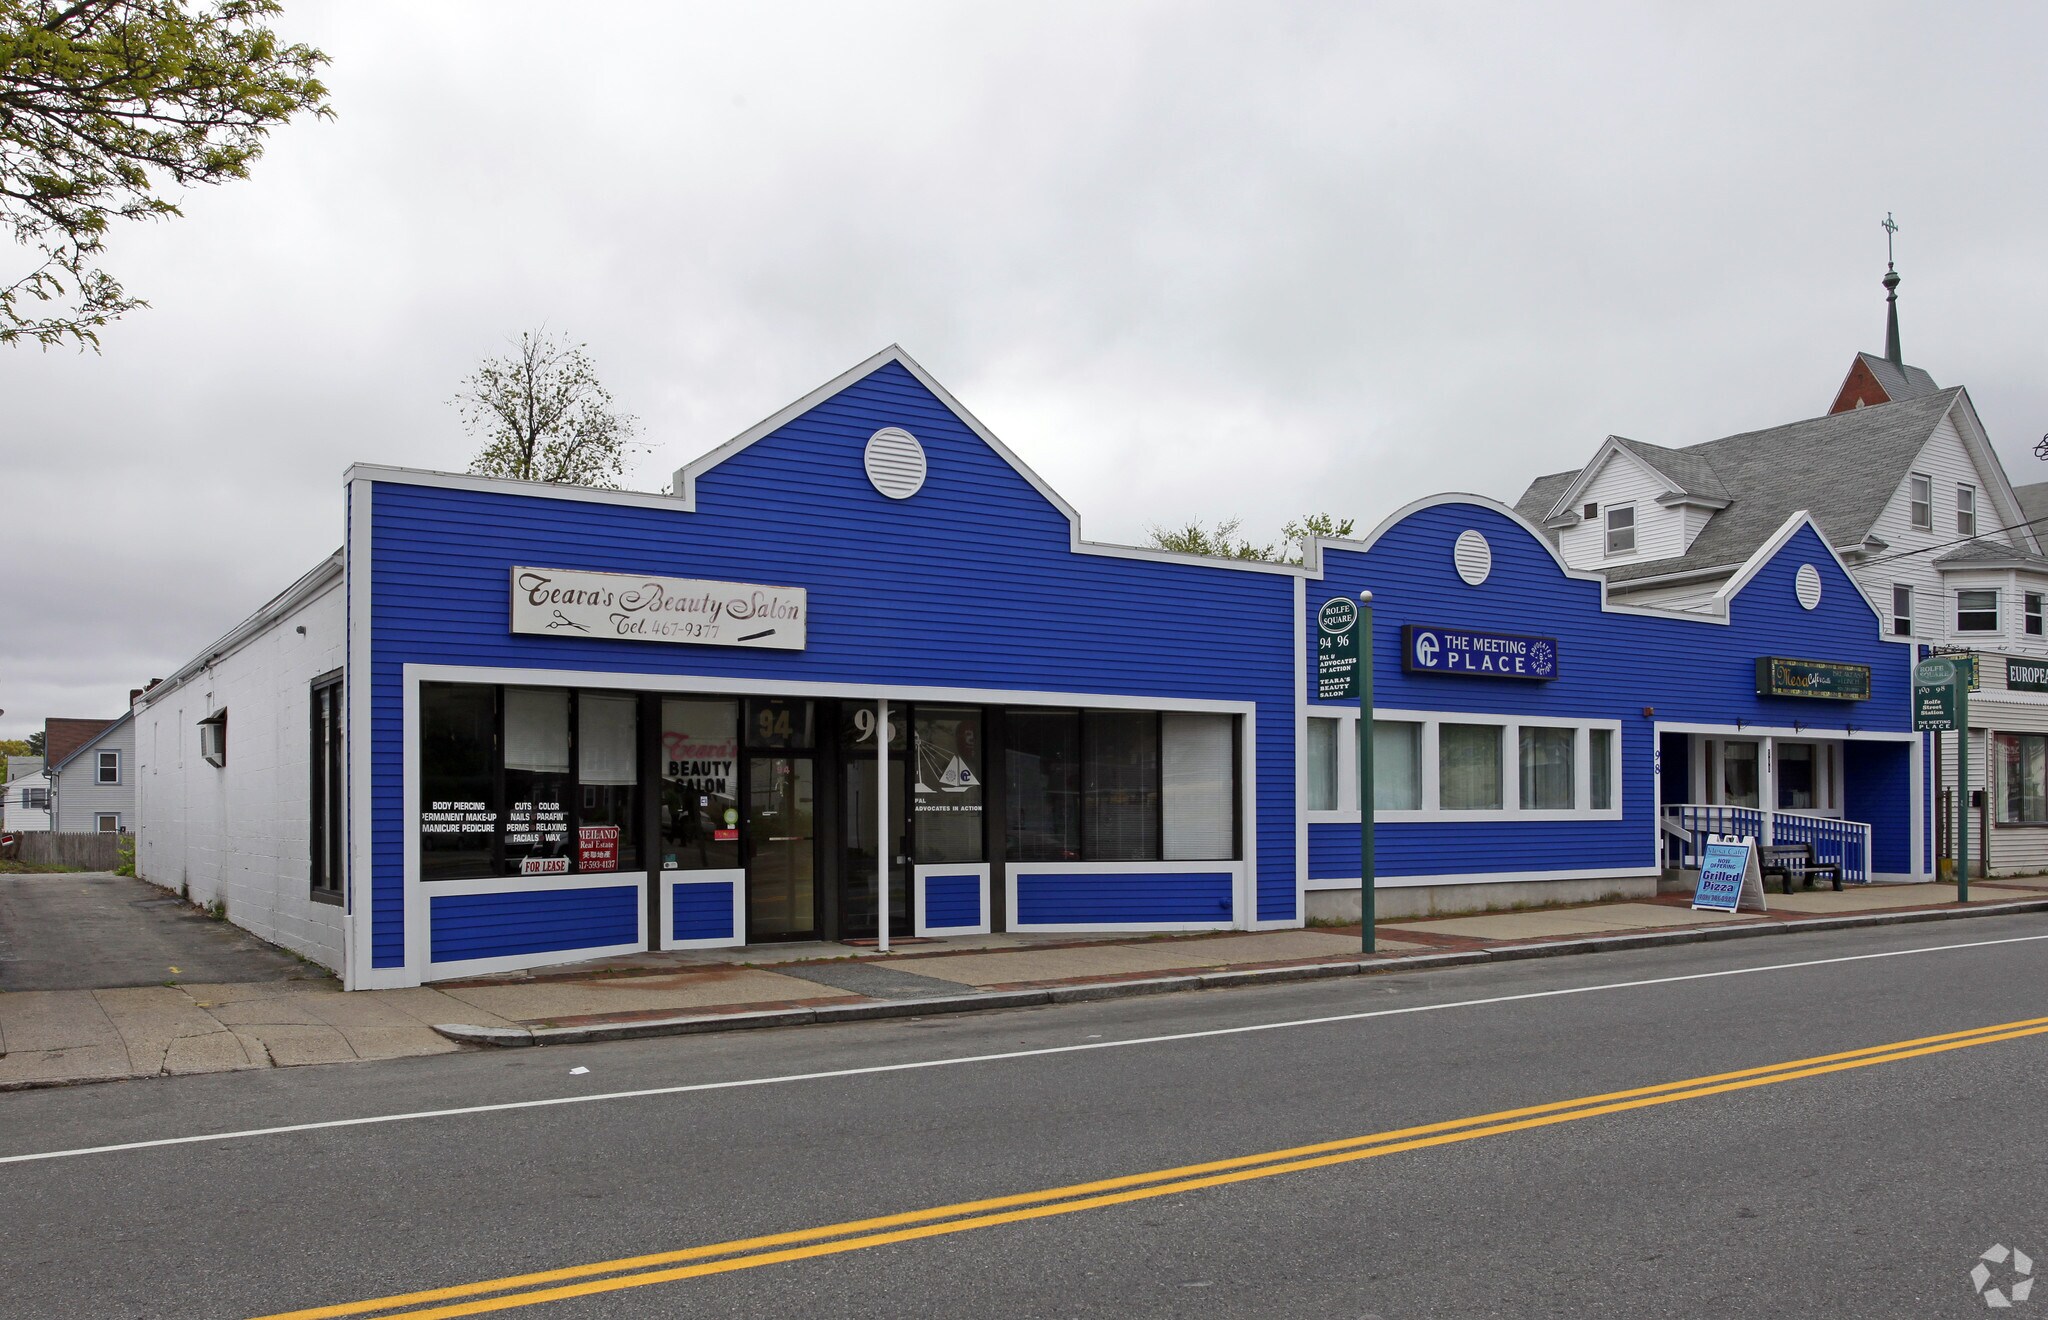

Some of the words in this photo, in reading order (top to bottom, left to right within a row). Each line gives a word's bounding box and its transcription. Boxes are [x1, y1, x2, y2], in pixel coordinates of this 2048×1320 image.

[518, 573, 613, 607] Teara's
[619, 583, 722, 622] Beauty
[1325, 605, 1350, 616] ROLFE
[1323, 614, 1352, 626] SQUARE
[609, 613, 647, 635] Tel.
[651, 622, 720, 639] 467-9377
[1319, 636, 1332, 650] 94
[1337, 634, 1349, 648] 96
[1444, 635, 1469, 650] THE
[1473, 637, 1526, 655] MEETING
[1319, 657, 1357, 667] ADVOCATES
[1448, 655, 1526, 673] PLACE
[1328, 665, 1351, 673] ACTION
[1320, 676, 1351, 685] TEARA'S
[1776, 666, 1809, 687] Mesa
[1320, 683, 1350, 691] BEAUTY
[1918, 686, 1930, 694] 100
[759, 709, 793, 739] 94
[854, 708, 896, 743] 96
[669, 761, 732, 776] BEAUTY
[676, 778, 726, 793] SALON
[432, 802, 451, 810] BODY
[454, 802, 486, 810] PIERCING
[515, 802, 532, 810] CUTS
[538, 802, 559, 810] COLOR
[466, 813, 497, 821] MAKE-UP
[511, 813, 530, 821] NAILS
[537, 813, 563, 821] PARAFIN
[422, 824, 460, 833] MANICURE
[462, 824, 495, 833] PEDICURE
[506, 823, 529, 831] PERMS
[536, 823, 567, 831] RELAXING
[513, 834, 539, 842] FACIALS
[545, 834, 561, 842] WAX
[579, 829, 618, 840] MEILAND
[580, 841, 594, 849] Real
[525, 861, 540, 872] FOR
[542, 861, 566, 871] LEASE
[1702, 870, 1740, 882] Grilled
[1702, 881, 1734, 892] Pizza
